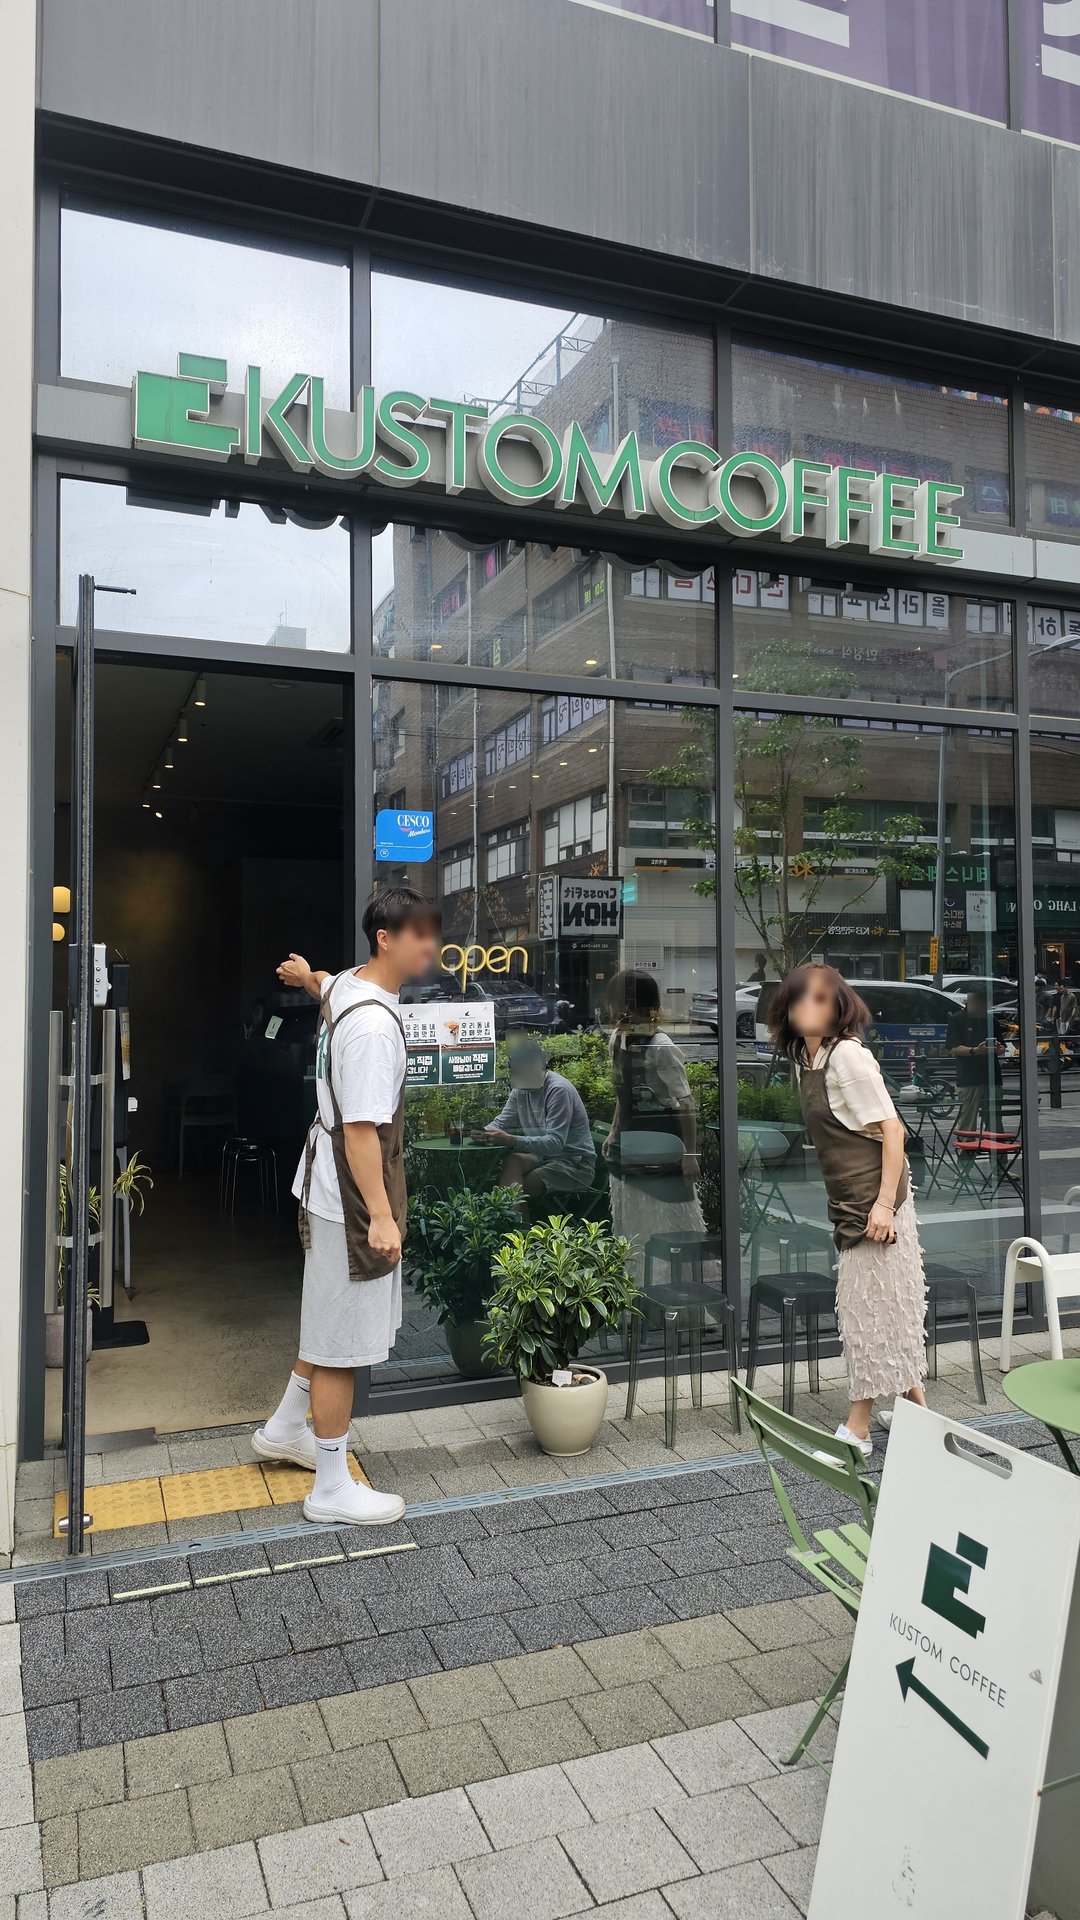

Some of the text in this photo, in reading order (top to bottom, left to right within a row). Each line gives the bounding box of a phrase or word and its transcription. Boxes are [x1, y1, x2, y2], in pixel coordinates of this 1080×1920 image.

[246, 366, 965, 563] KUSTOM COFFEE
[397, 814, 430, 828] CESCO
[441, 943, 528, 994] open
[416, 1056, 432, 1065] 직접
[448, 1053, 488, 1064] 사장님이 직접
[889, 1612, 1007, 1709] KUSTOM COFFEE
